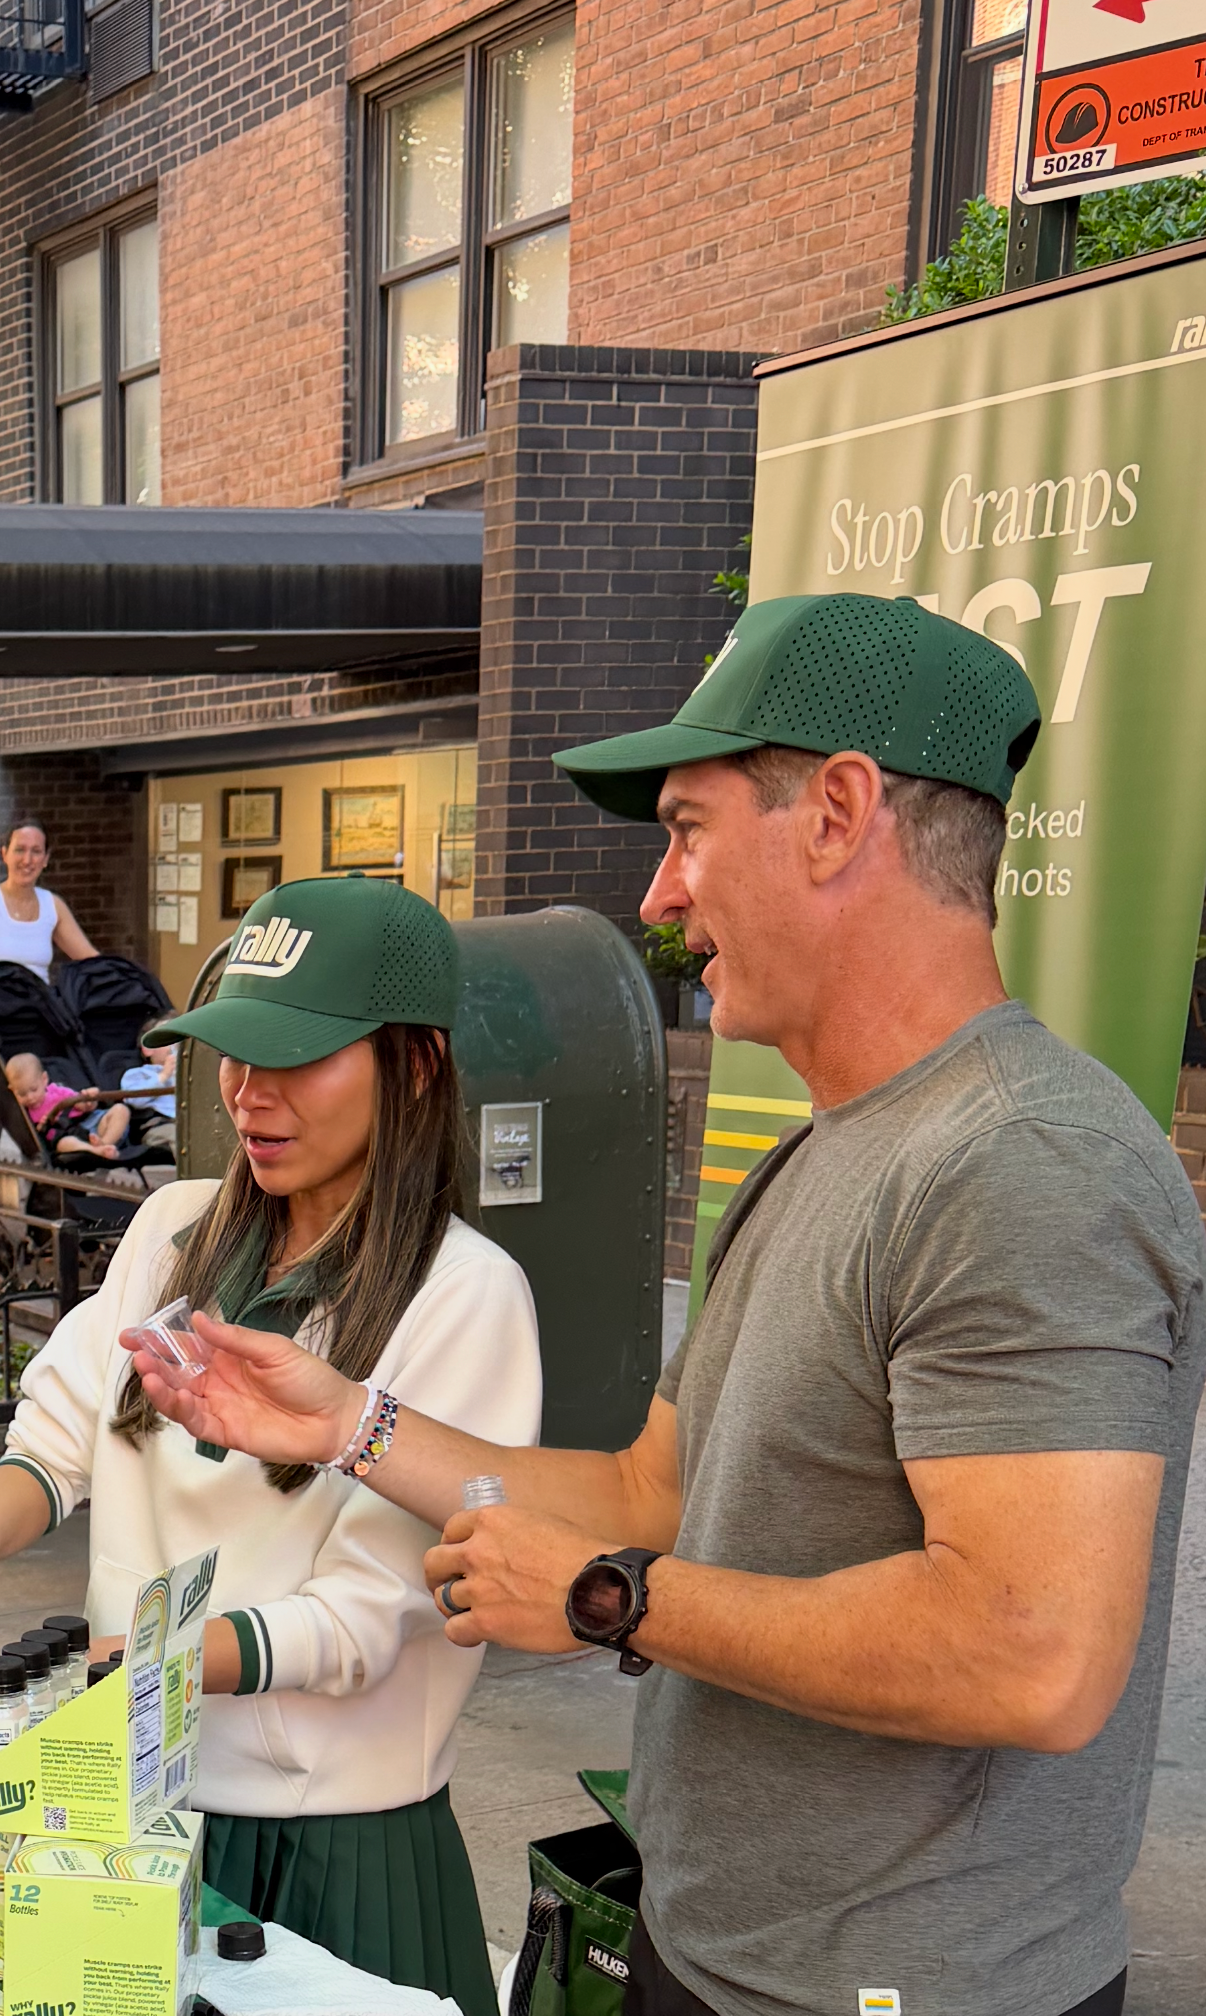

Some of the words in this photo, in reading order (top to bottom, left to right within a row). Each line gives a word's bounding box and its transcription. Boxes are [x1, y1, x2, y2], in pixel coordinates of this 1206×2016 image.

[1118, 88, 1206, 124] CONSTRU
[1143, 134, 1167, 146] DEPT
[1169, 131, 1182, 141] OF
[1043, 149, 1107, 175] 50287
[1170, 315, 1206, 352] ra
[826, 498, 923, 584] Stop
[940, 463, 1140, 555] Cramps
[927, 562, 1152, 724] ST
[1007, 800, 1085, 839] cked
[1000, 861, 1073, 897] hots
[224, 917, 313, 978] rally
[177, 1550, 218, 1631] rally
[81, 1767, 112, 1775] proprietary
[0, 1780, 36, 1815] lly?
[9, 1884, 41, 1904] 12
[9, 1904, 38, 1916] Bottles
[128, 1977, 163, 1985] performing
[136, 1970, 159, 1978] holding
[10, 2000, 33, 2011] WHY
[126, 1991, 160, 1999] proprietary
